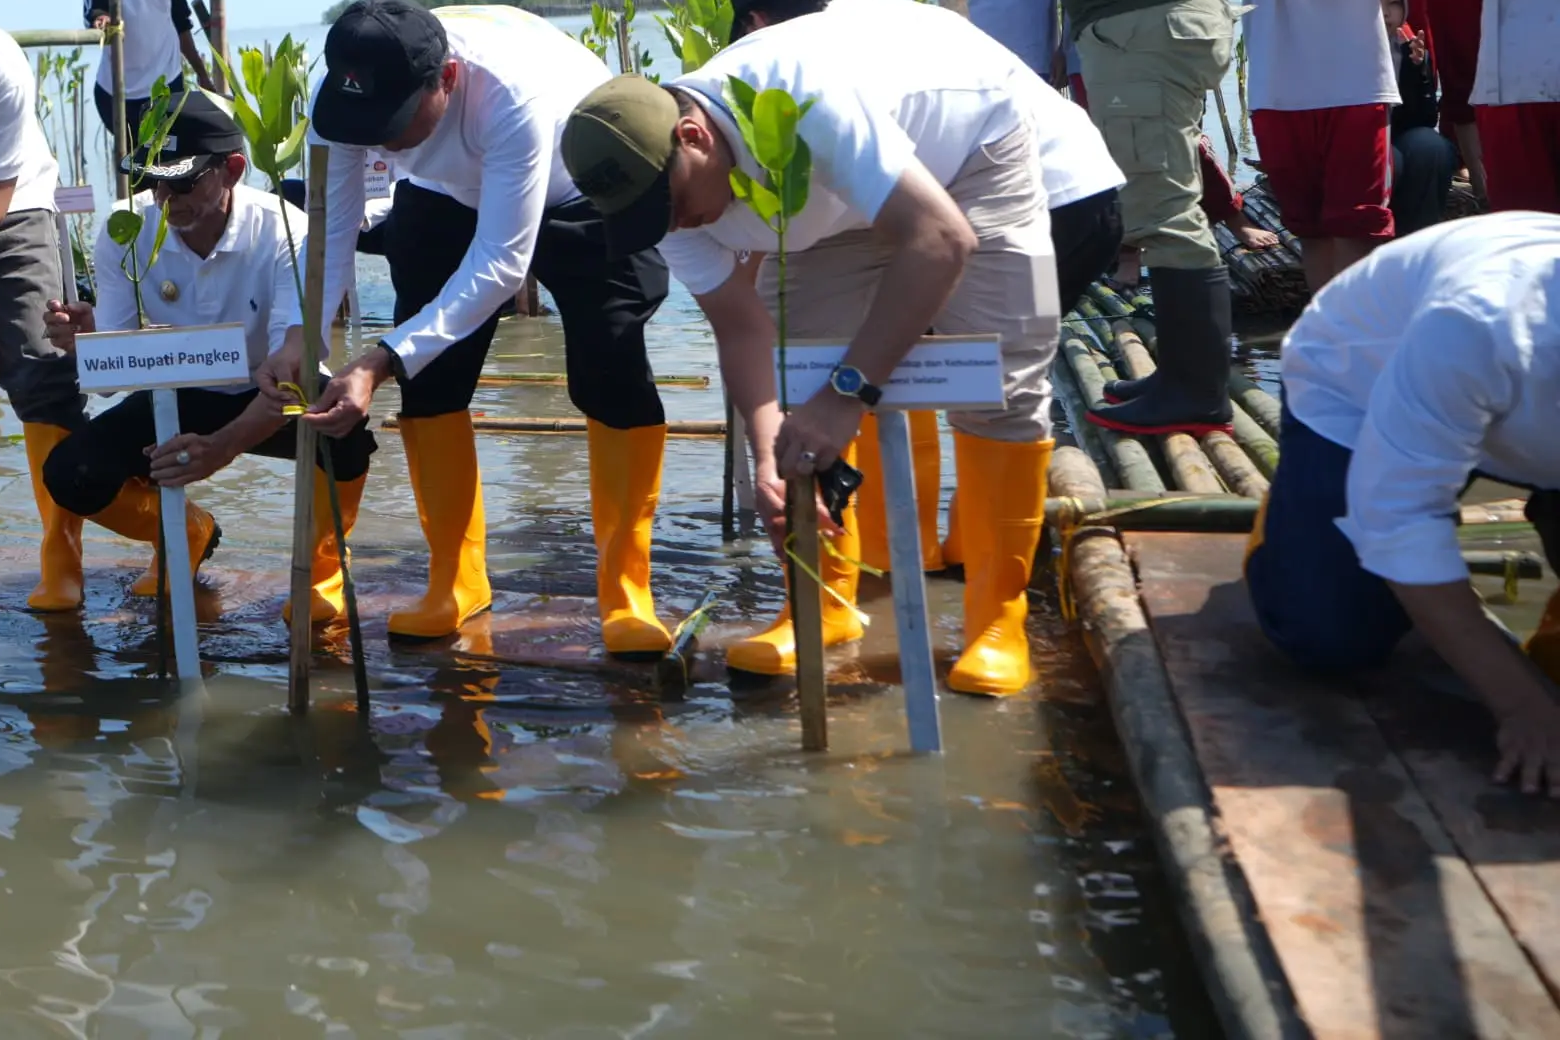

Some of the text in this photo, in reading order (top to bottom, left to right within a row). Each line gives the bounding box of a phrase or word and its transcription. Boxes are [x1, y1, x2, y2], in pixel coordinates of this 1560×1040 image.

[84, 348, 240, 372] Wakil Bupati Pangkep
